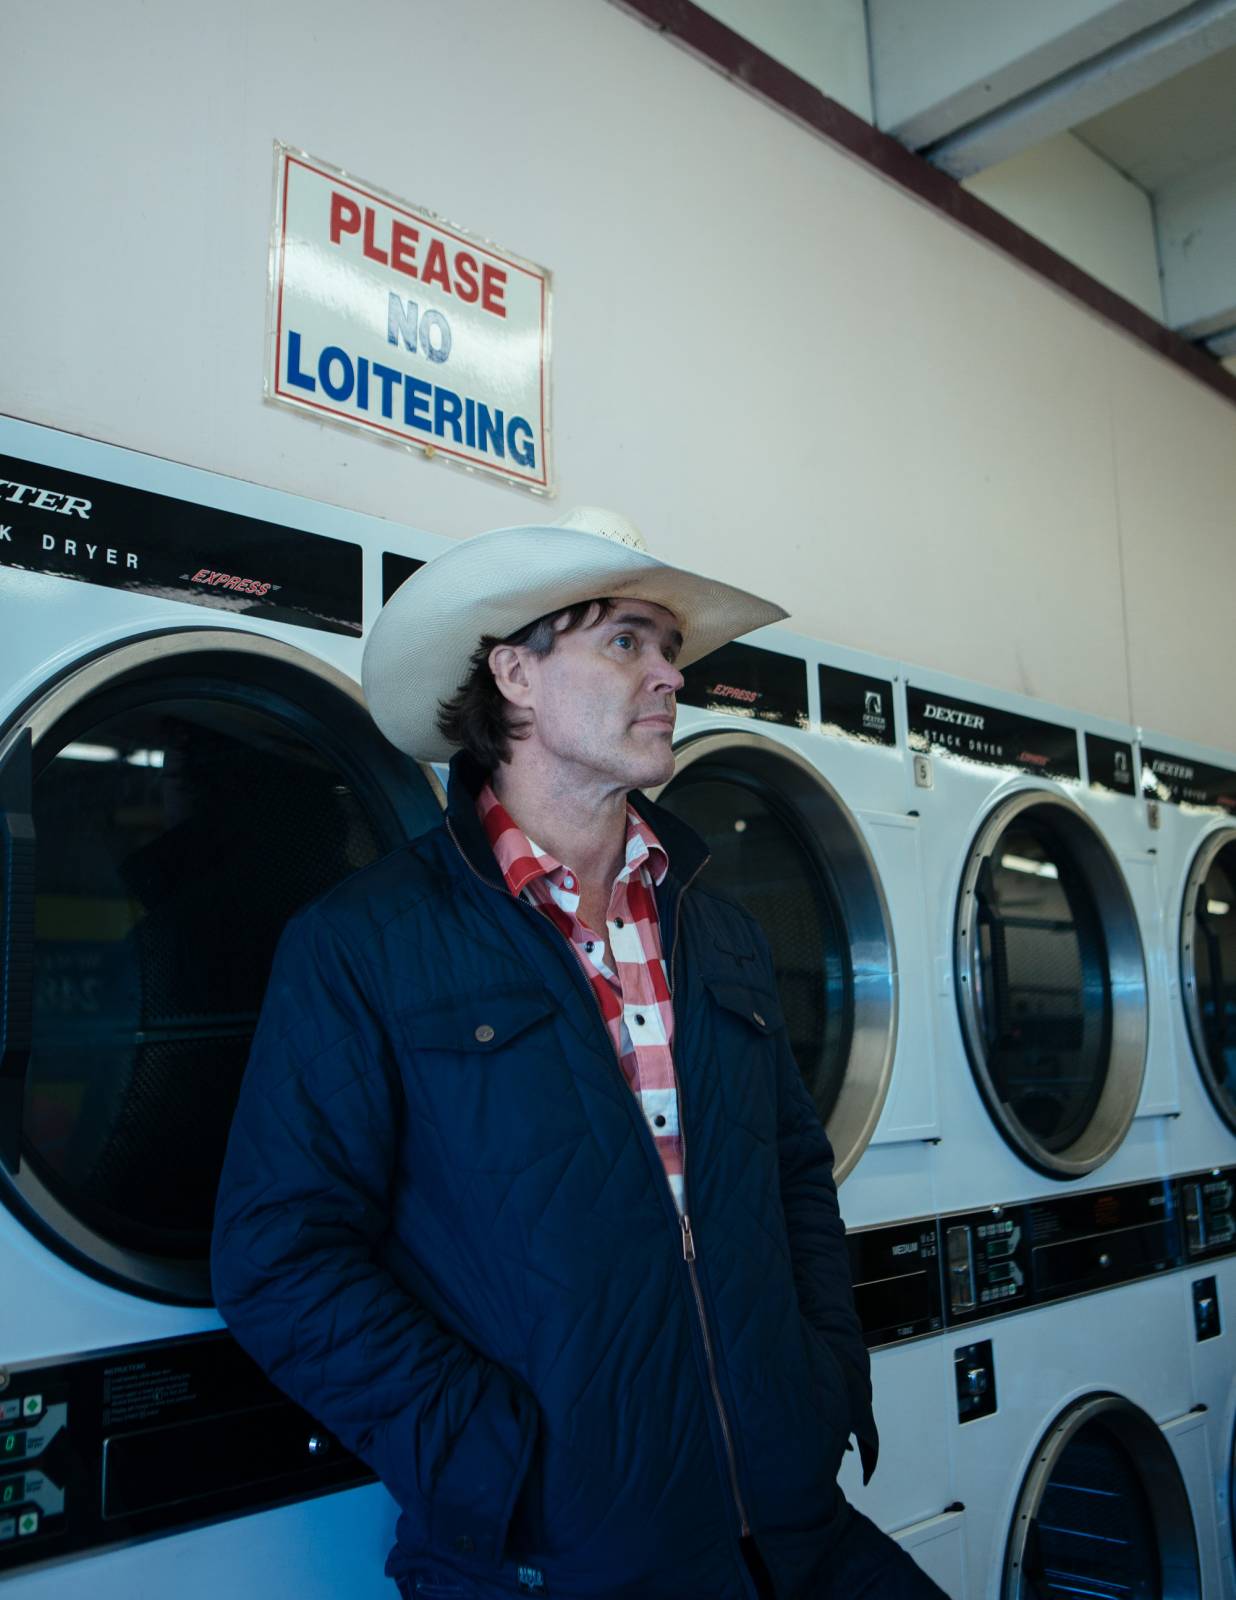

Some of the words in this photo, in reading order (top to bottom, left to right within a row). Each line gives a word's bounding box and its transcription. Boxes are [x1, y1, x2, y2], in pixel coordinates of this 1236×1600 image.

[330, 191, 507, 318] PLEASE
[388, 292, 452, 364] NO
[287, 329, 536, 469] LOITERING
[42, 534, 138, 569] DRYER
[191, 569, 272, 596] EXPRESS
[713, 684, 757, 702] EXPRESS
[924, 704, 985, 730] DEXTER
[924, 730, 961, 746] STACK
[969, 740, 1003, 756] DRYER
